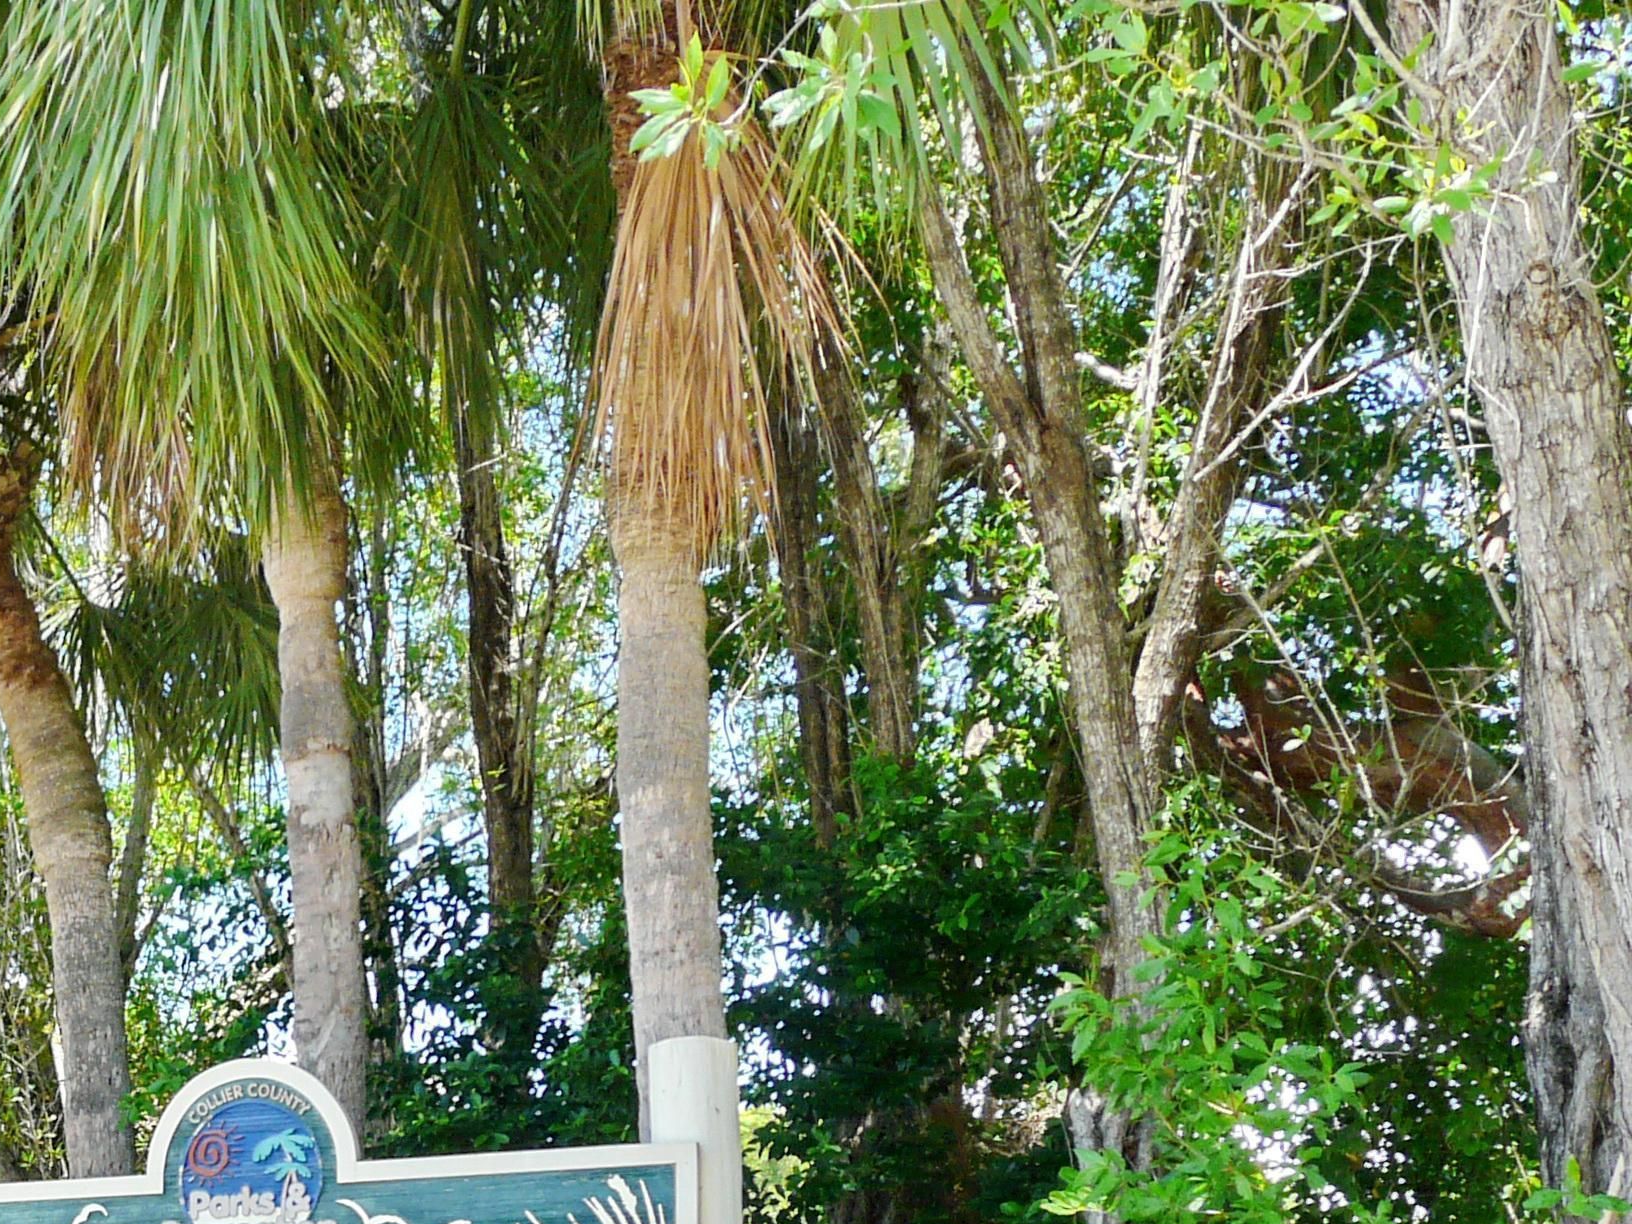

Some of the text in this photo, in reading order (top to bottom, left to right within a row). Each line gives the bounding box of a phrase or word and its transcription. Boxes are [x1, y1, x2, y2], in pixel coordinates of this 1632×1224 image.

[188, 1083, 311, 1124] COLLIER COUNTY
[190, 1183, 311, 1219] Parks &
